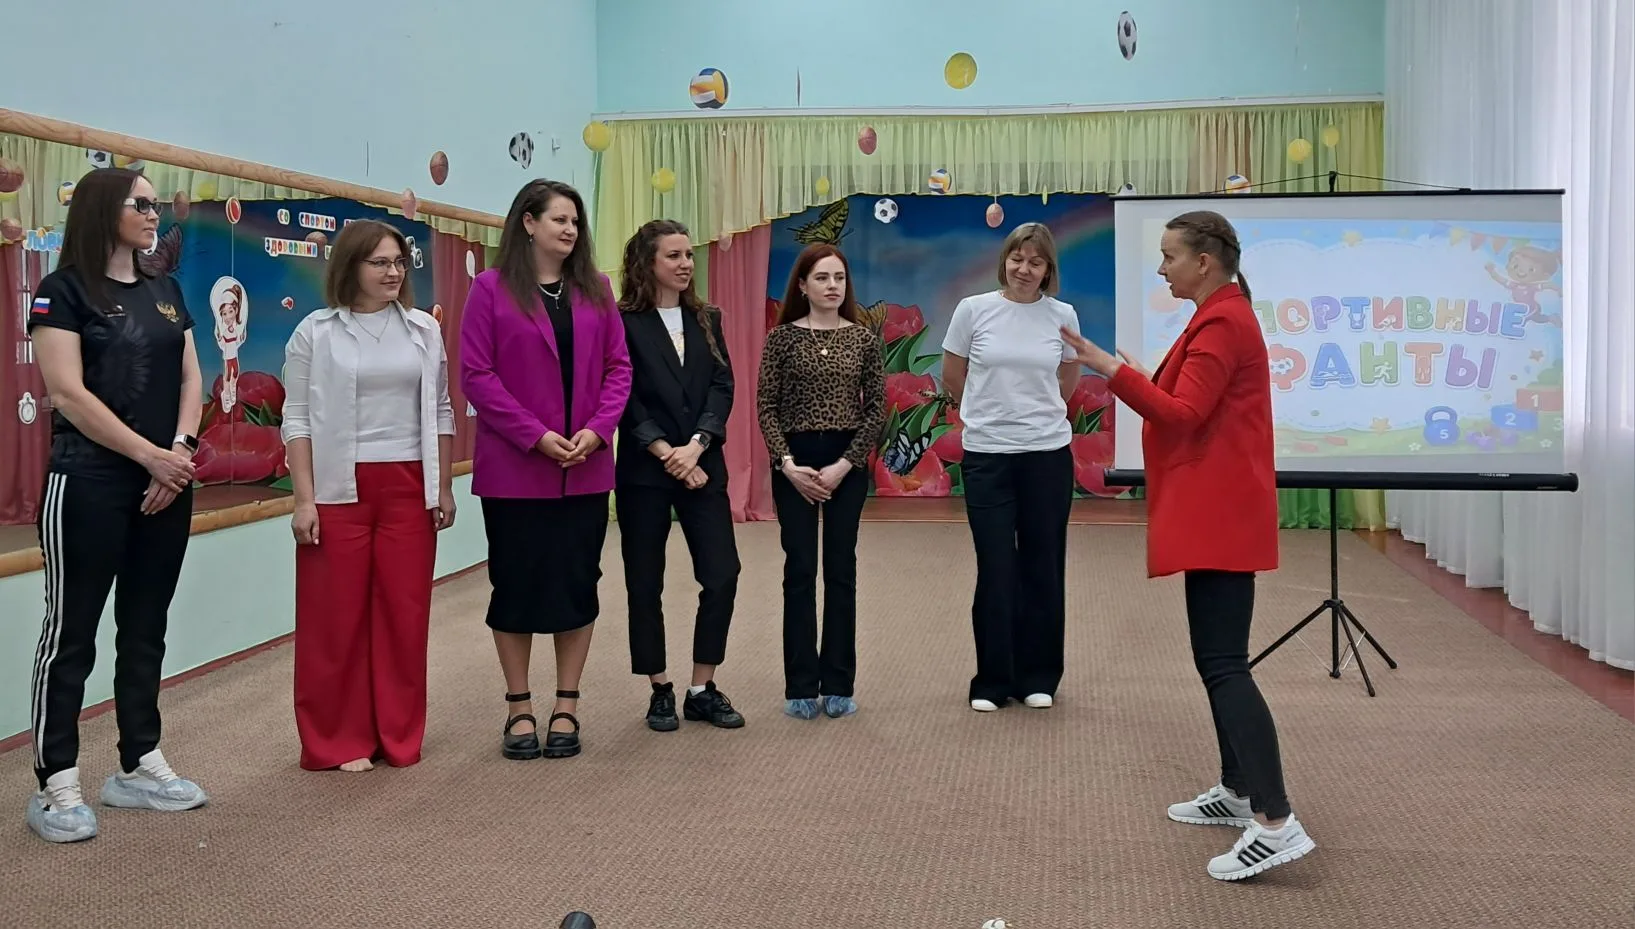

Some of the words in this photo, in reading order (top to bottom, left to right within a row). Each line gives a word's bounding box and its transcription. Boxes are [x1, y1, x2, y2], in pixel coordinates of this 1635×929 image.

[278, 209, 290, 224] СО
[1253, 295, 1529, 338] ПОРТИВНЫЕ
[1268, 341, 1497, 392] ФАНТЫ
[1531, 394, 1539, 408] 1
[1504, 412, 1517, 426] 2
[1439, 428, 1449, 440] 5
